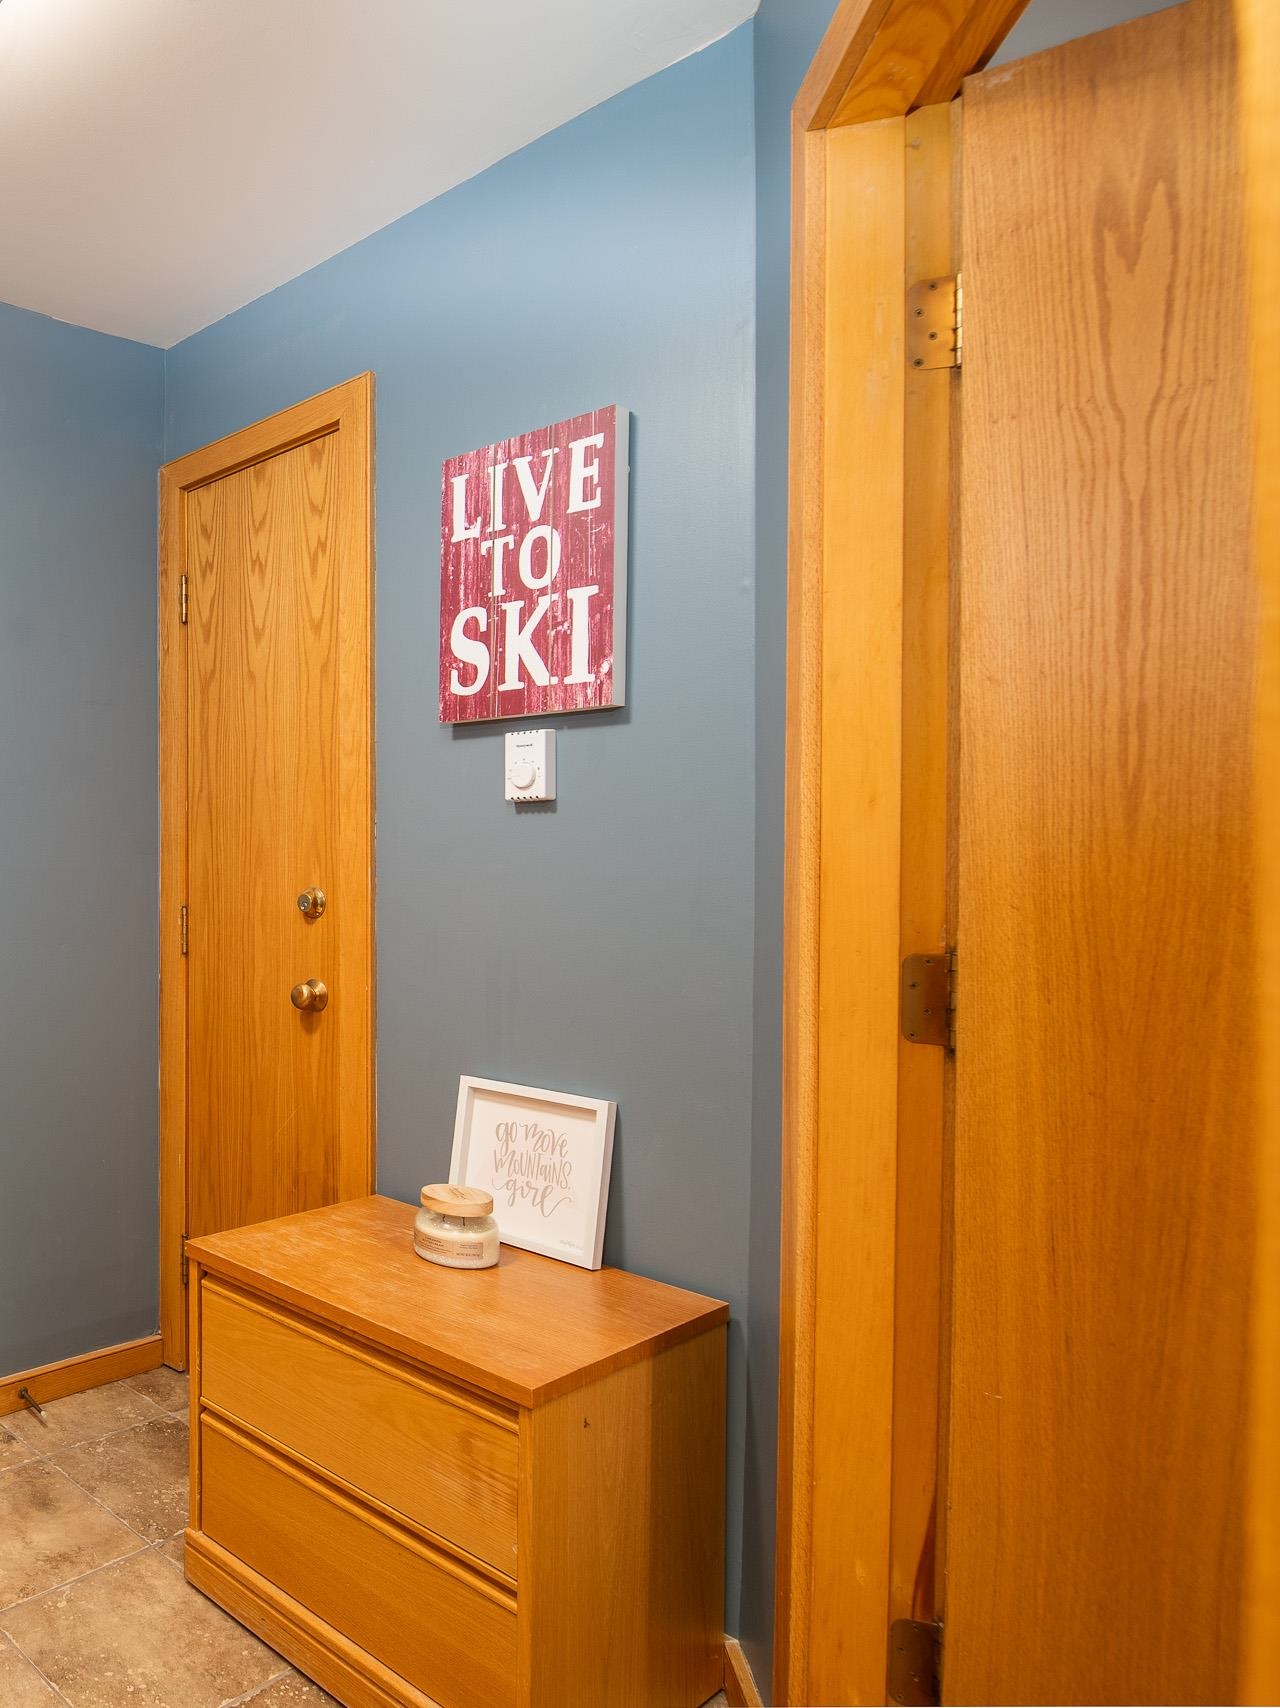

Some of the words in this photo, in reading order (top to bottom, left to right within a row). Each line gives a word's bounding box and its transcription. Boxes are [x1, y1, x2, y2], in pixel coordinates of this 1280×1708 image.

[451, 432, 605, 543] LIVE
[481, 525, 561, 597] TO
[450, 585, 599, 696] SKI
[495, 1121, 517, 1156] go
[519, 1121, 569, 1157] move
[492, 1177, 572, 1218] girl
